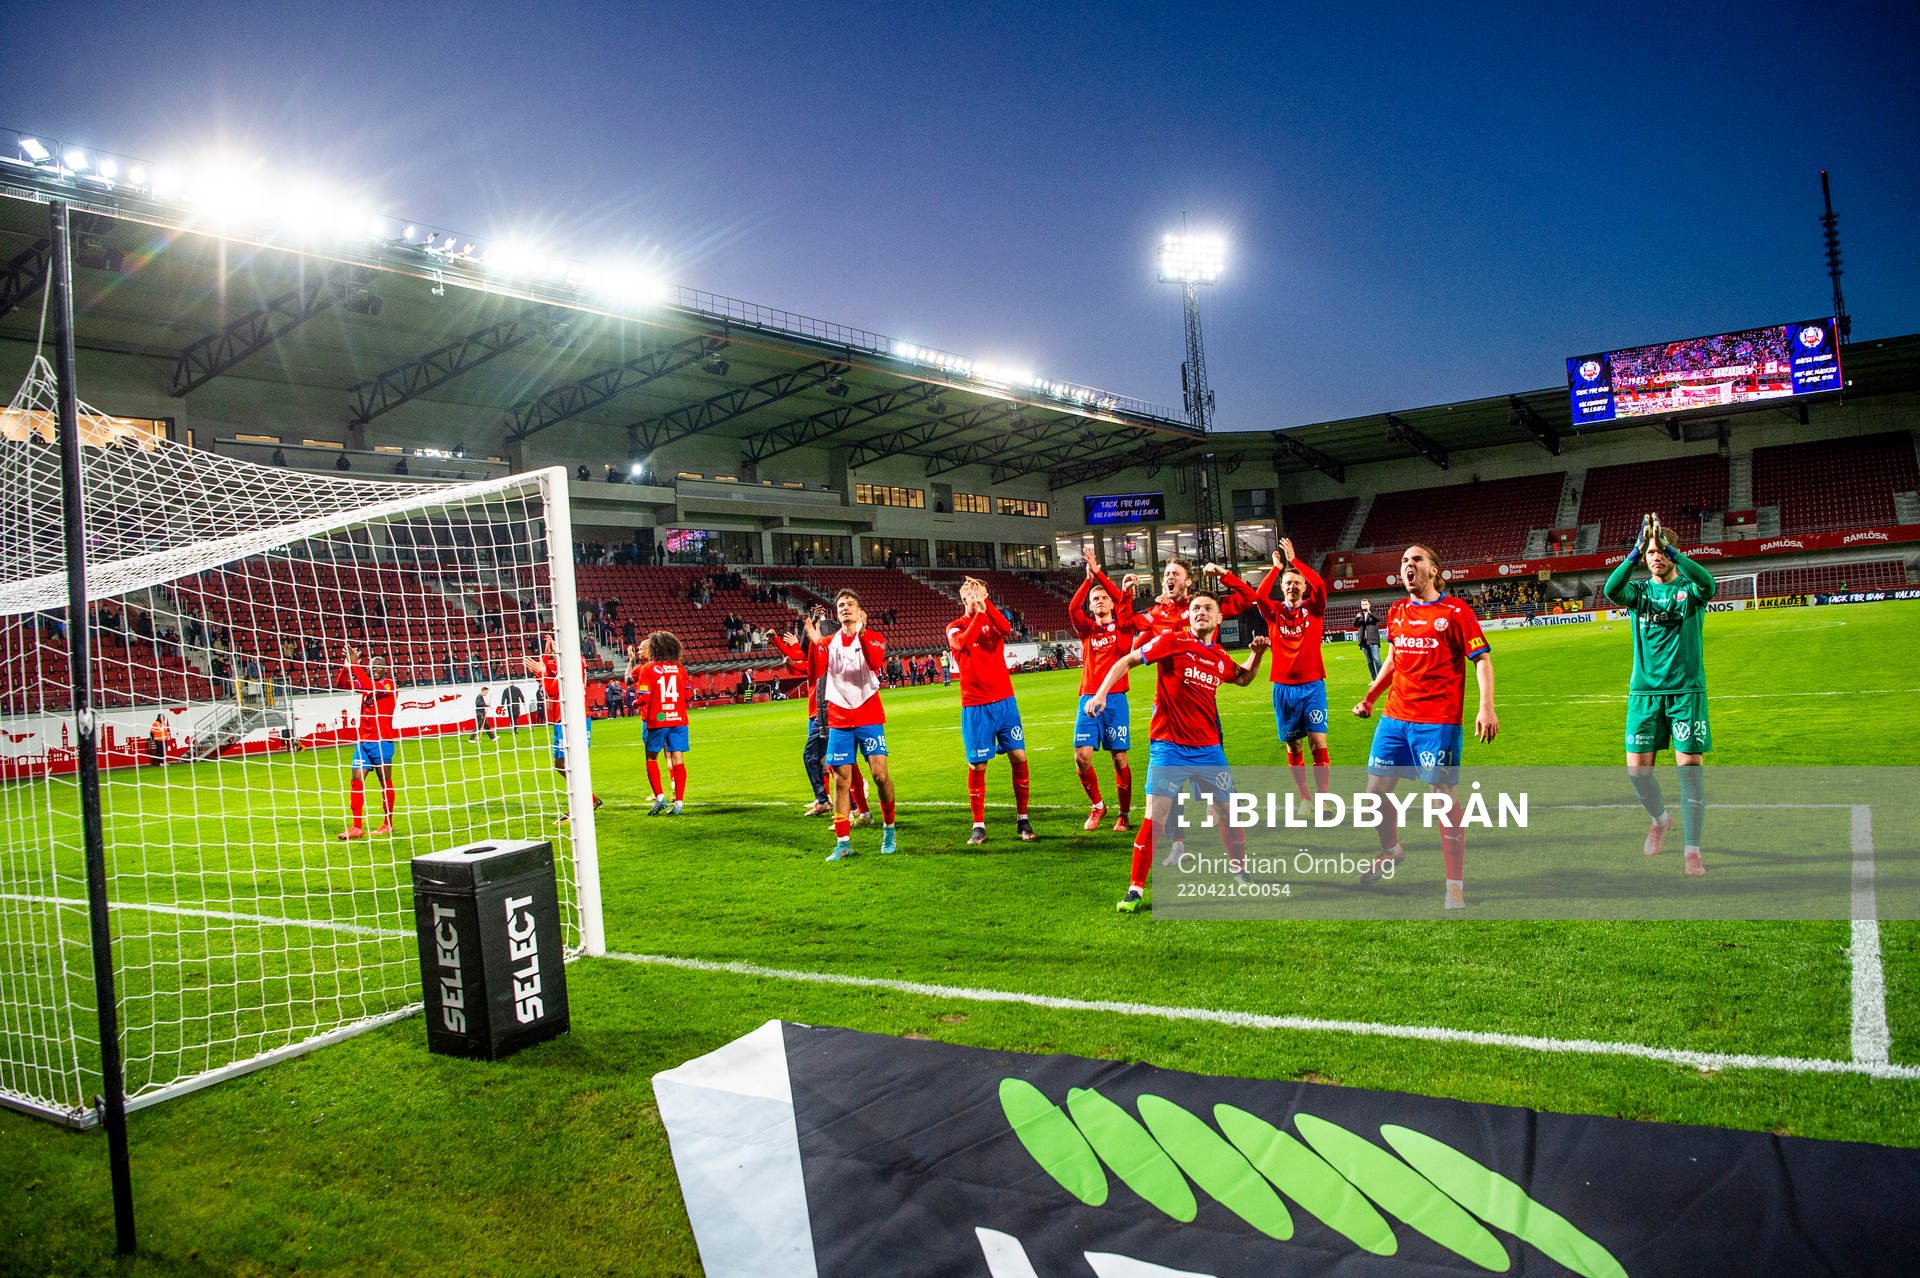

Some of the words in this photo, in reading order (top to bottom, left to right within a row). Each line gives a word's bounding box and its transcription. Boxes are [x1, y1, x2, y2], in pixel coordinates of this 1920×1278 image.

[1843, 530, 1889, 544] RAMLÖSA
[1760, 538, 1804, 552] RAMLÖSA
[1542, 613, 1591, 626] Tillmobil
[1394, 634, 1424, 648] akea
[1468, 636, 1485, 650] XXL
[1184, 666, 1213, 684] akea
[657, 674, 680, 703] 14
[1117, 725, 1128, 737] 20
[1693, 720, 1707, 736] 25
[1437, 750, 1453, 766] 21
[505, 895, 545, 1024] SELECT
[432, 903, 468, 1034] SELECT
